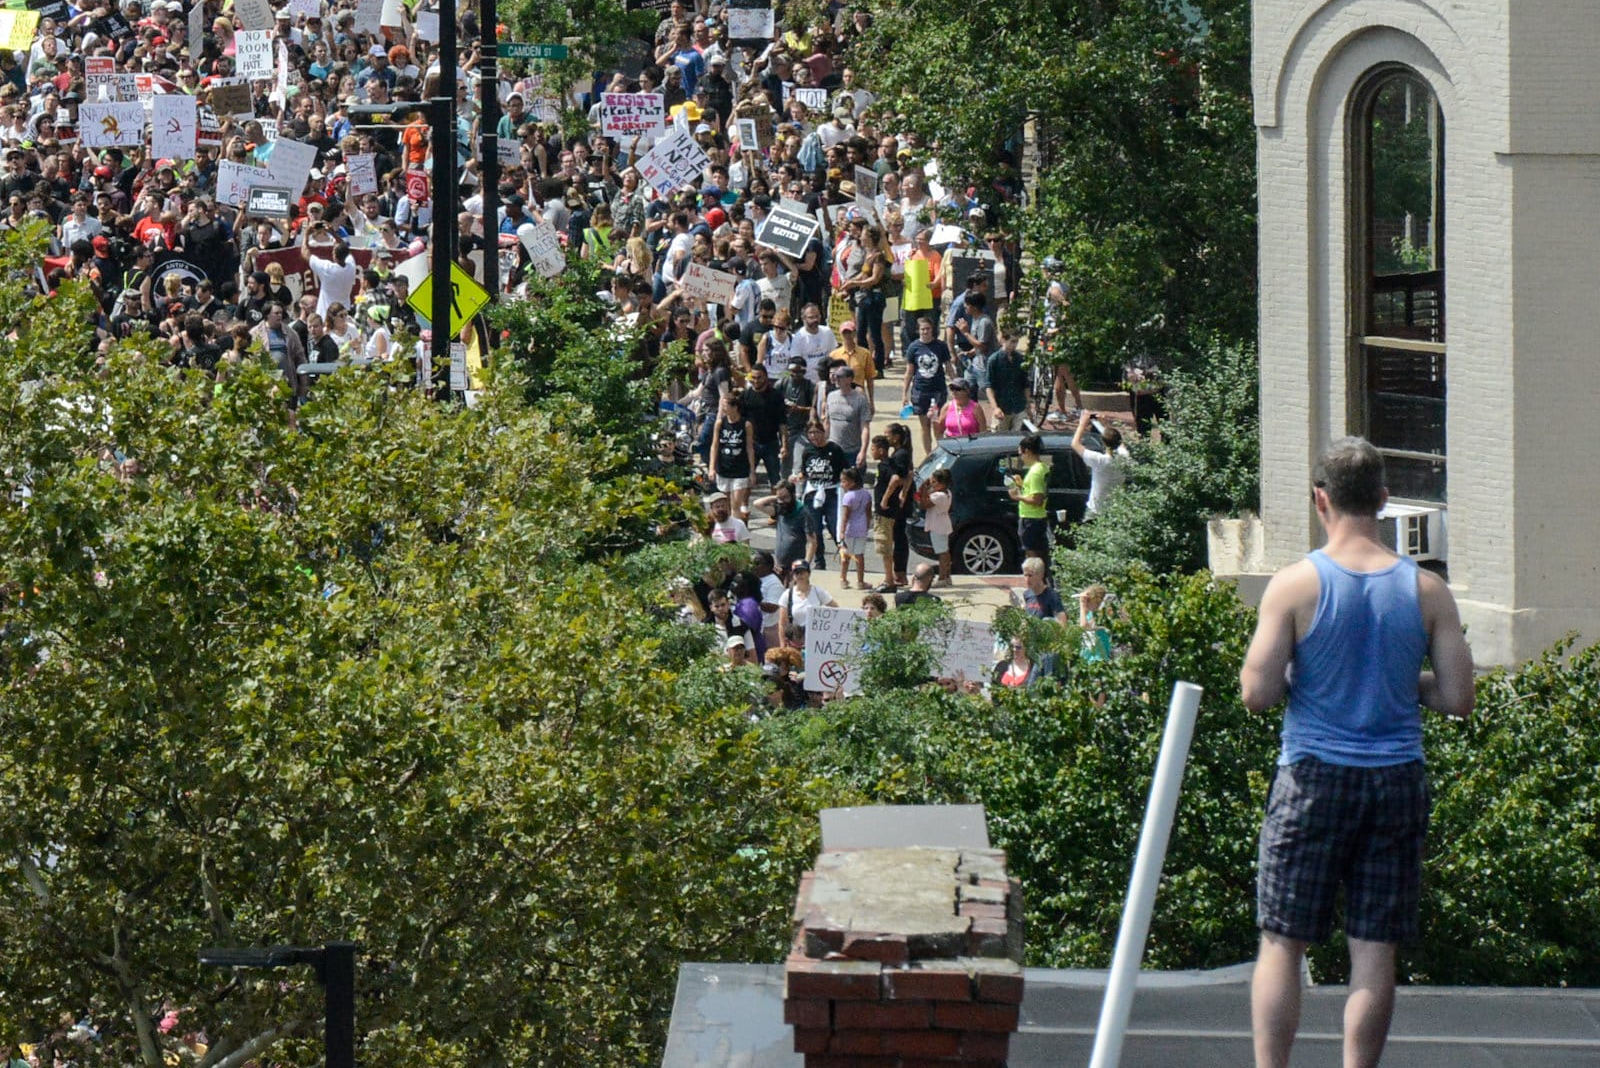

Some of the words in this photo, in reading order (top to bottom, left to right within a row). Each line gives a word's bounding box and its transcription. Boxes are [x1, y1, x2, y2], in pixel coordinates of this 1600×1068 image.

[245, 33, 260, 42] NO
[238, 43, 269, 53] ROOM
[507, 44, 541, 56] CAMDEN
[544, 48, 553, 56] ST
[243, 61, 263, 70] HATE
[87, 74, 113, 85] STOP
[605, 94, 658, 107] RESIST
[673, 132, 711, 170] HATE
[664, 150, 699, 178] NOT
[770, 215, 791, 228] BLACK
[791, 222, 812, 235] LIVES
[772, 227, 799, 241] MATTER
[813, 608, 839, 620] NOT
[811, 622, 831, 632] BIG
[815, 641, 852, 656] NAZI
